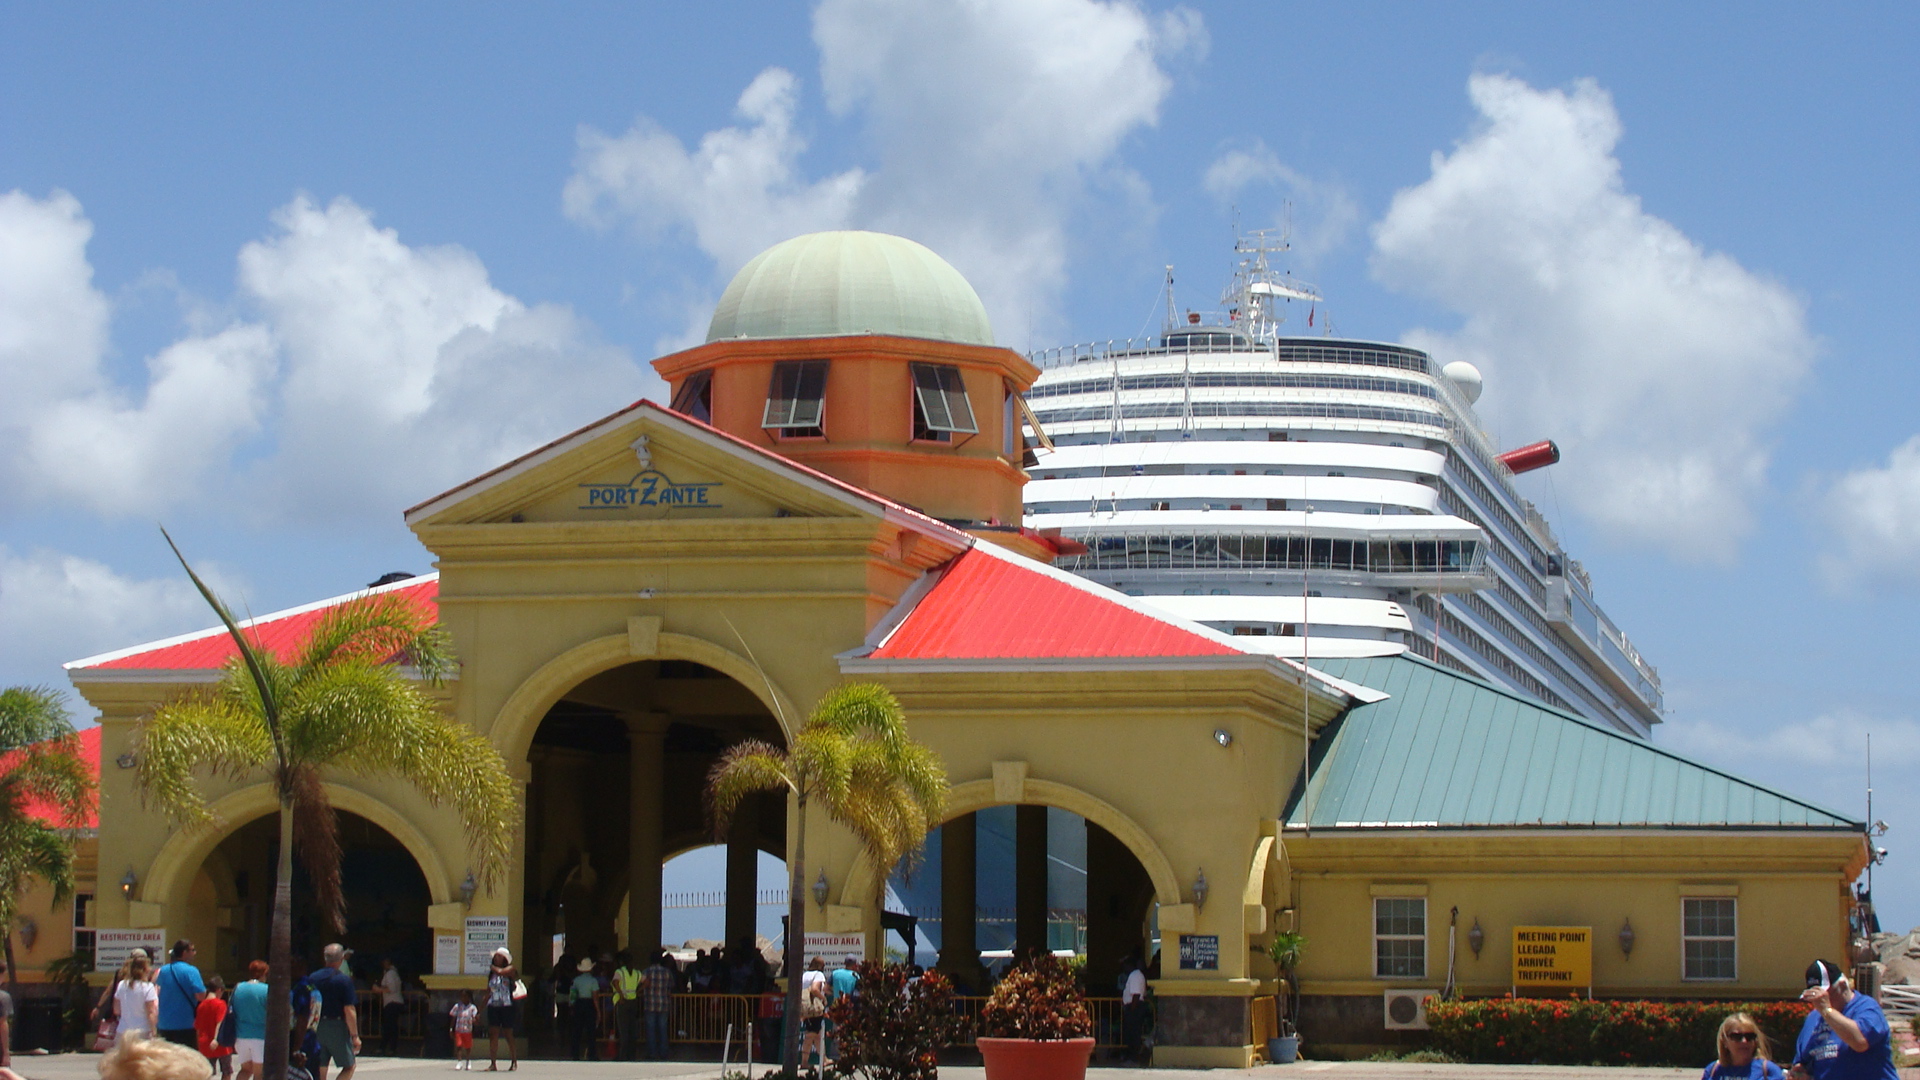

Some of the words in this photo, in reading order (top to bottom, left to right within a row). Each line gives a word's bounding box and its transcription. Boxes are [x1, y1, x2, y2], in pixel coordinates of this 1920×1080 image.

[589, 488, 638, 504] PORT
[100, 933, 141, 941] RESTRICTED
[143, 933, 161, 941] AREA
[803, 937, 839, 946] STRICTED
[840, 937, 861, 946] AREA
[1517, 931, 1557, 942] MEETING
[1559, 932, 1586, 943] POINT
[1517, 945, 1556, 955] LLEGADA
[1517, 970, 1573, 981] TREFFPUNKT
